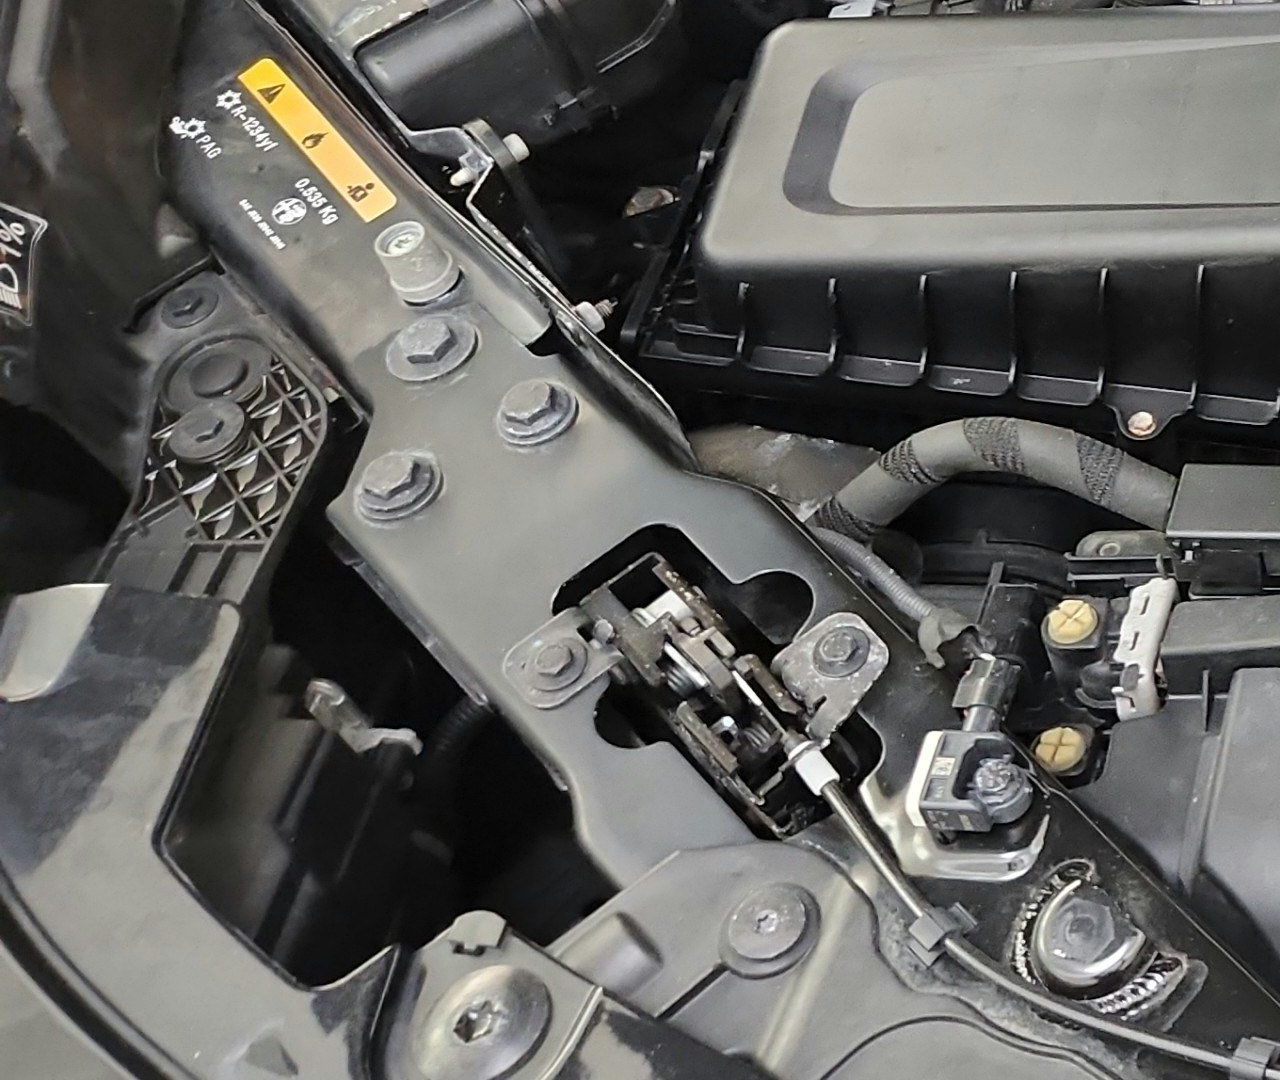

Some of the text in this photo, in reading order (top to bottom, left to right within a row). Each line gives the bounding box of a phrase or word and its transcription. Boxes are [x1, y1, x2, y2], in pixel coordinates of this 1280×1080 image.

[196, 134, 222, 160] PAG
[295, 177, 339, 226] 0.535 Kg
